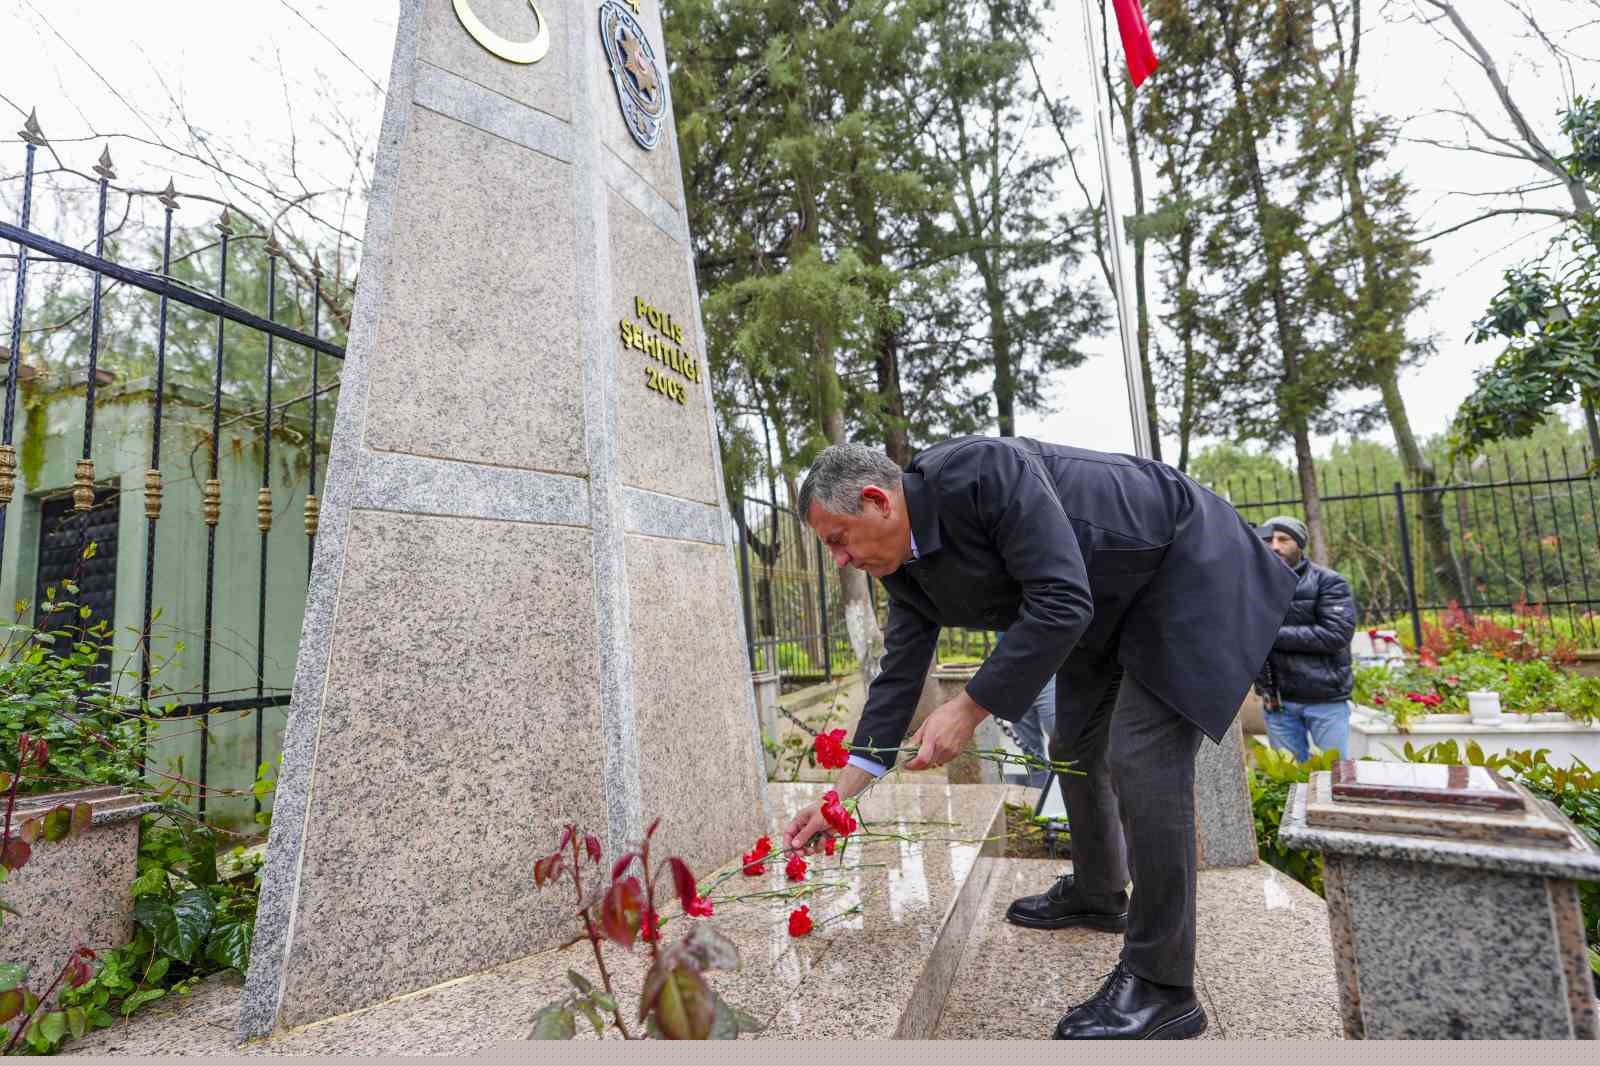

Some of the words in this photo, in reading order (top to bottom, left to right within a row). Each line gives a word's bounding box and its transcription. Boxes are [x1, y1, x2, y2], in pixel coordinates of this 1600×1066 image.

[634, 296, 685, 346] POLİS
[619, 319, 700, 384] ŞEHİTLİĞİ
[644, 366, 688, 406] 2003
